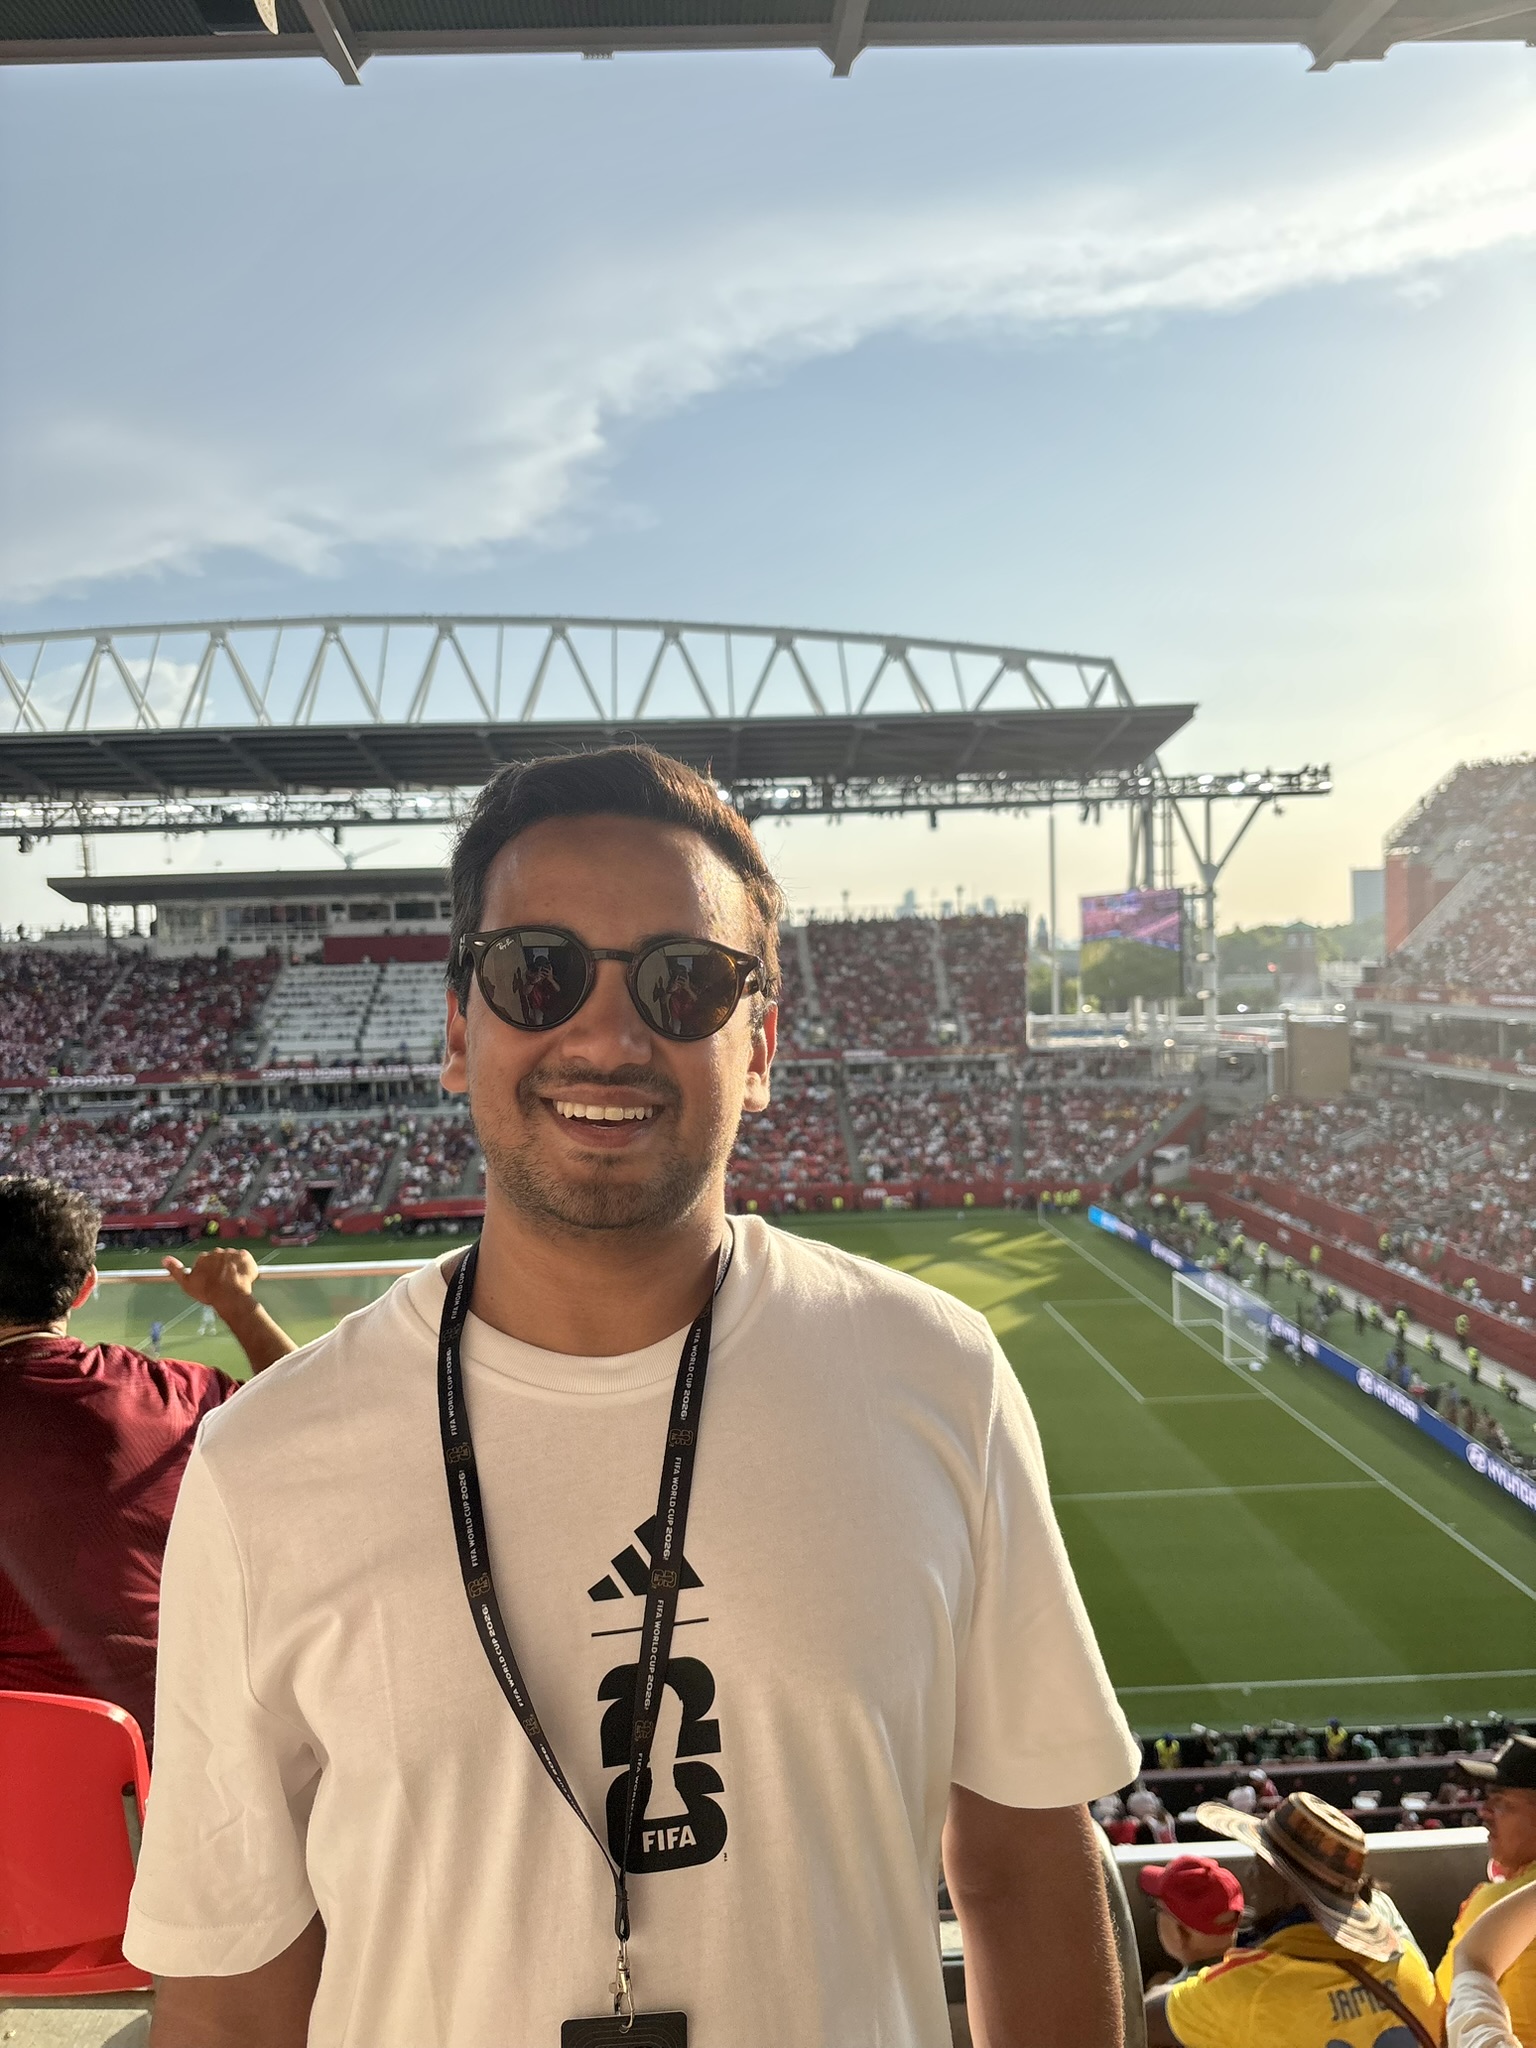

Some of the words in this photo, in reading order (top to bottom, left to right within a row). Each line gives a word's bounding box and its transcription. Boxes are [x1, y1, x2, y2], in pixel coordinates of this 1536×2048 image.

[48, 1074, 136, 1088] TORONTO
[454, 1285, 463, 1306] WORLD
[693, 1328, 702, 1344] FIFA
[687, 1344, 699, 1372] WORLD
[685, 1373, 694, 1389] CUP
[447, 1390, 455, 1418] WORLD
[449, 1418, 458, 1436] FIFA
[673, 1456, 682, 1475] FIFA
[669, 1476, 679, 1508] WORLD
[462, 1501, 472, 1517] CUP
[666, 1508, 675, 1526] CUP
[465, 1517, 476, 1548] WORLD
[470, 1548, 479, 1567] FIFA
[655, 1599, 664, 1619] FIFA
[491, 1637, 502, 1655] CUP
[650, 1620, 662, 1653] WORLD
[498, 1655, 515, 1688] WORLD
[648, 1654, 657, 1673] CUP
[512, 1688, 525, 1708] FIFA
[642, 1825, 697, 1853] FIFA
